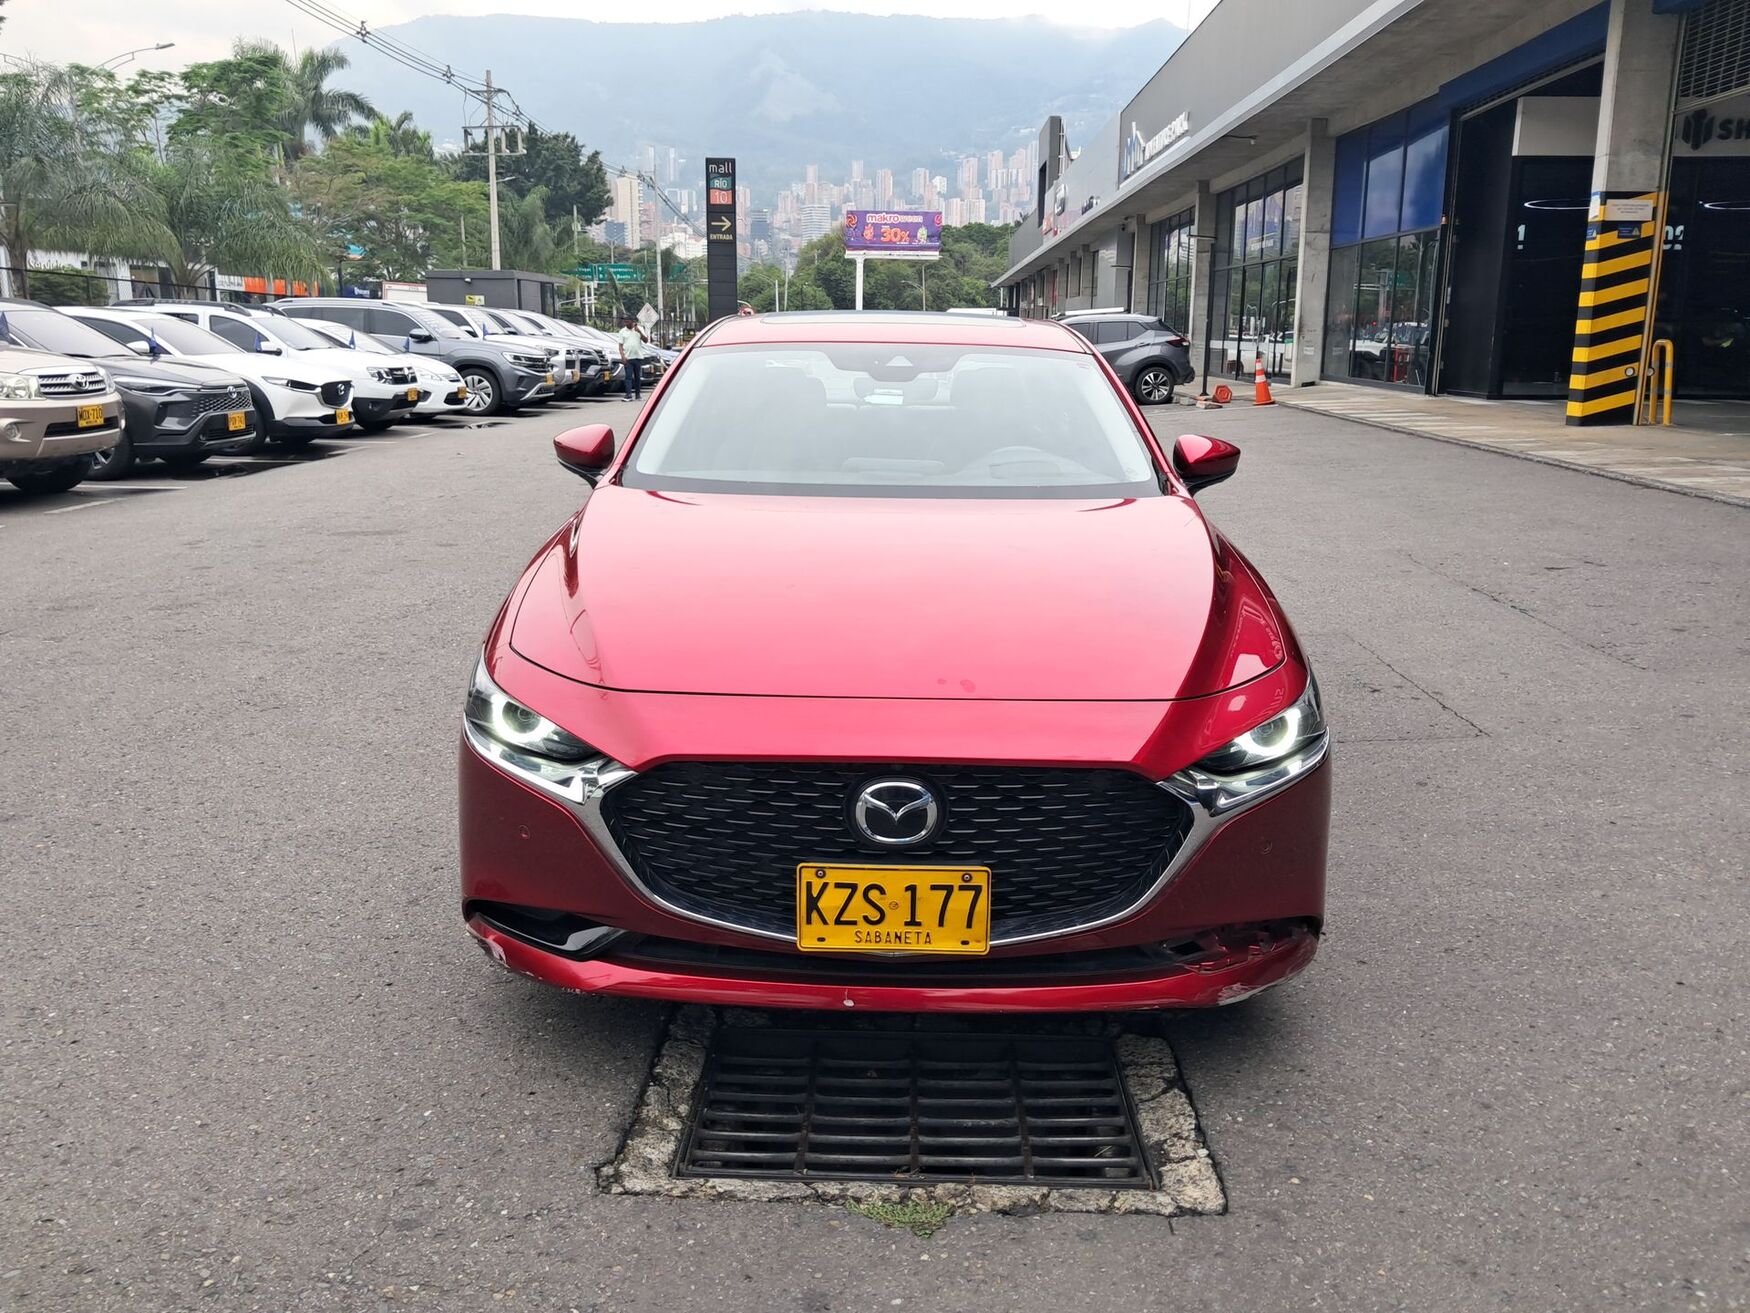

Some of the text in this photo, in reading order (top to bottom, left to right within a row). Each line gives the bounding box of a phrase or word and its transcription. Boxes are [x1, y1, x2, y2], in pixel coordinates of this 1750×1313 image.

[709, 162, 732, 173] mall
[714, 177, 727, 188] RÍO
[715, 191, 728, 204] 10
[709, 233, 733, 241] ENTRADA
[880, 227, 909, 242] 30%
[805, 881, 983, 929] KZS 177
[854, 930, 932, 945] SABANETA
